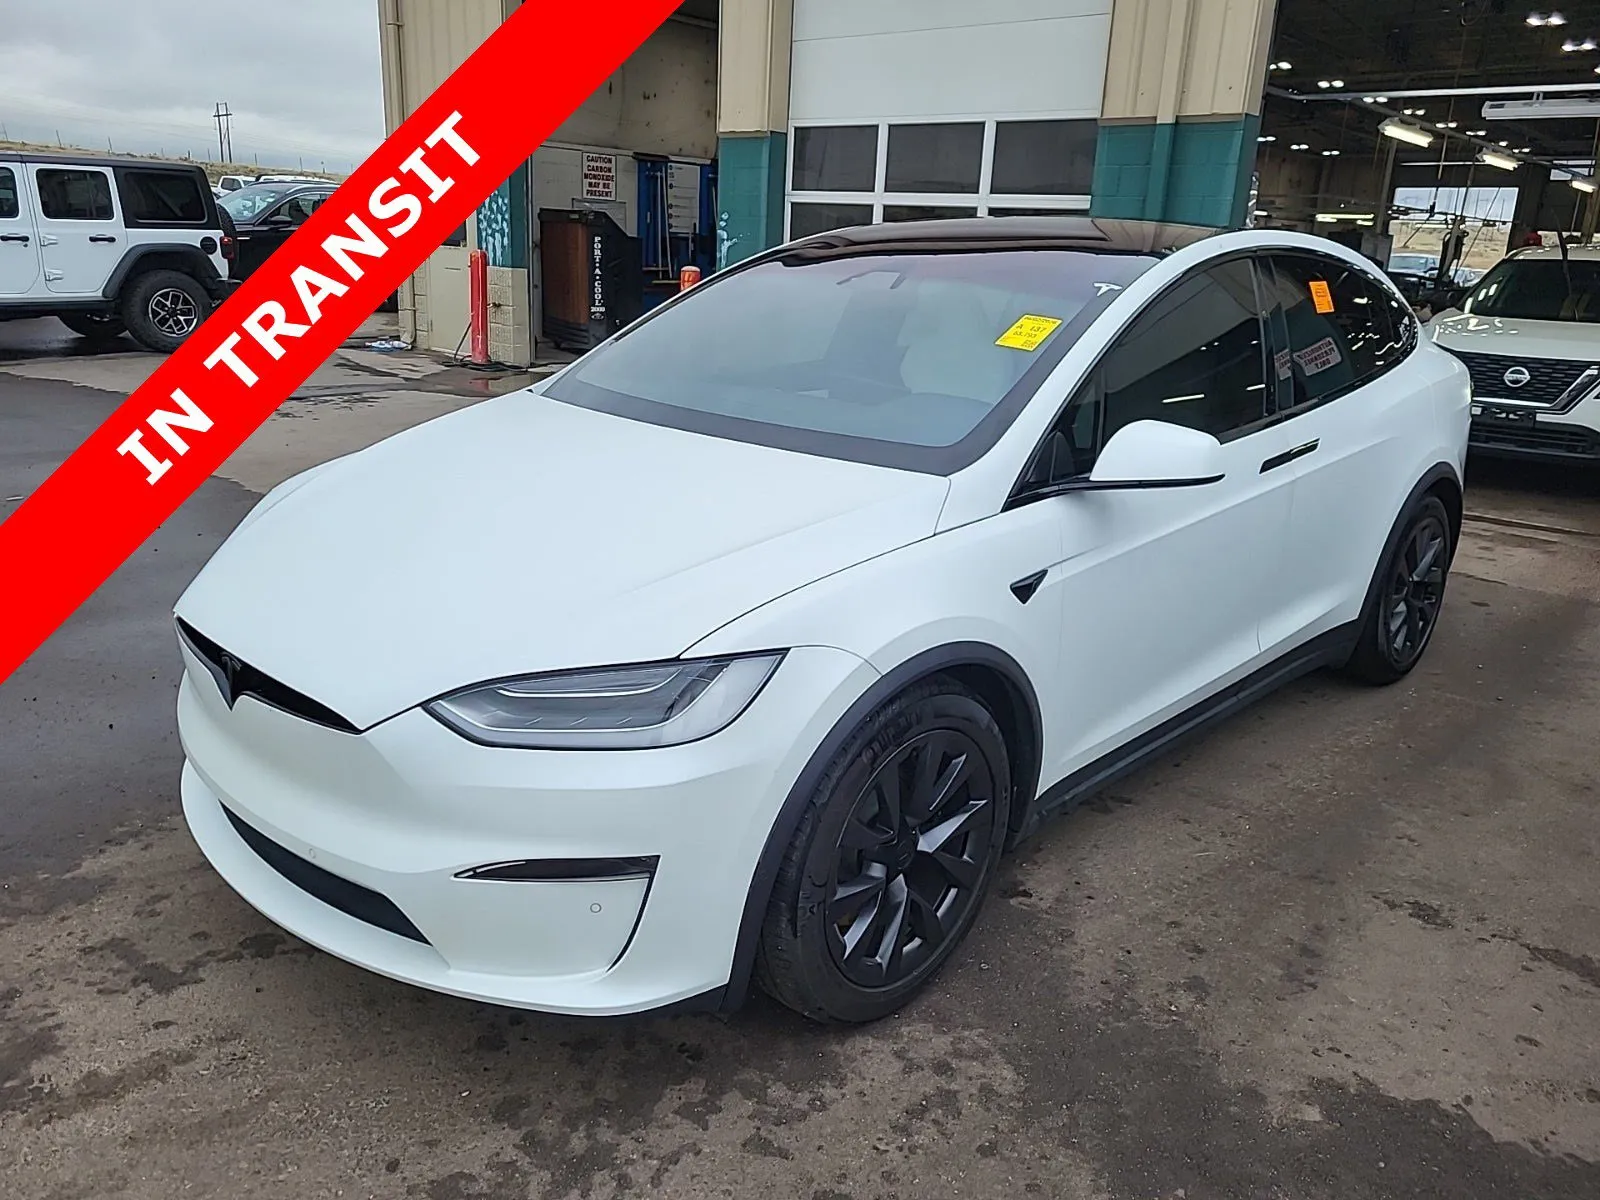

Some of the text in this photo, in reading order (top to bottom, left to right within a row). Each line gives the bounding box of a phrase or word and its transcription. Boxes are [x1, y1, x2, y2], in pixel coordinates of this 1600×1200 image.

[586, 155, 613, 164] CAUTION
[587, 164, 612, 173] CARBON
[583, 172, 615, 182] MONOXIDE
[586, 189, 613, 198] PRESENT
